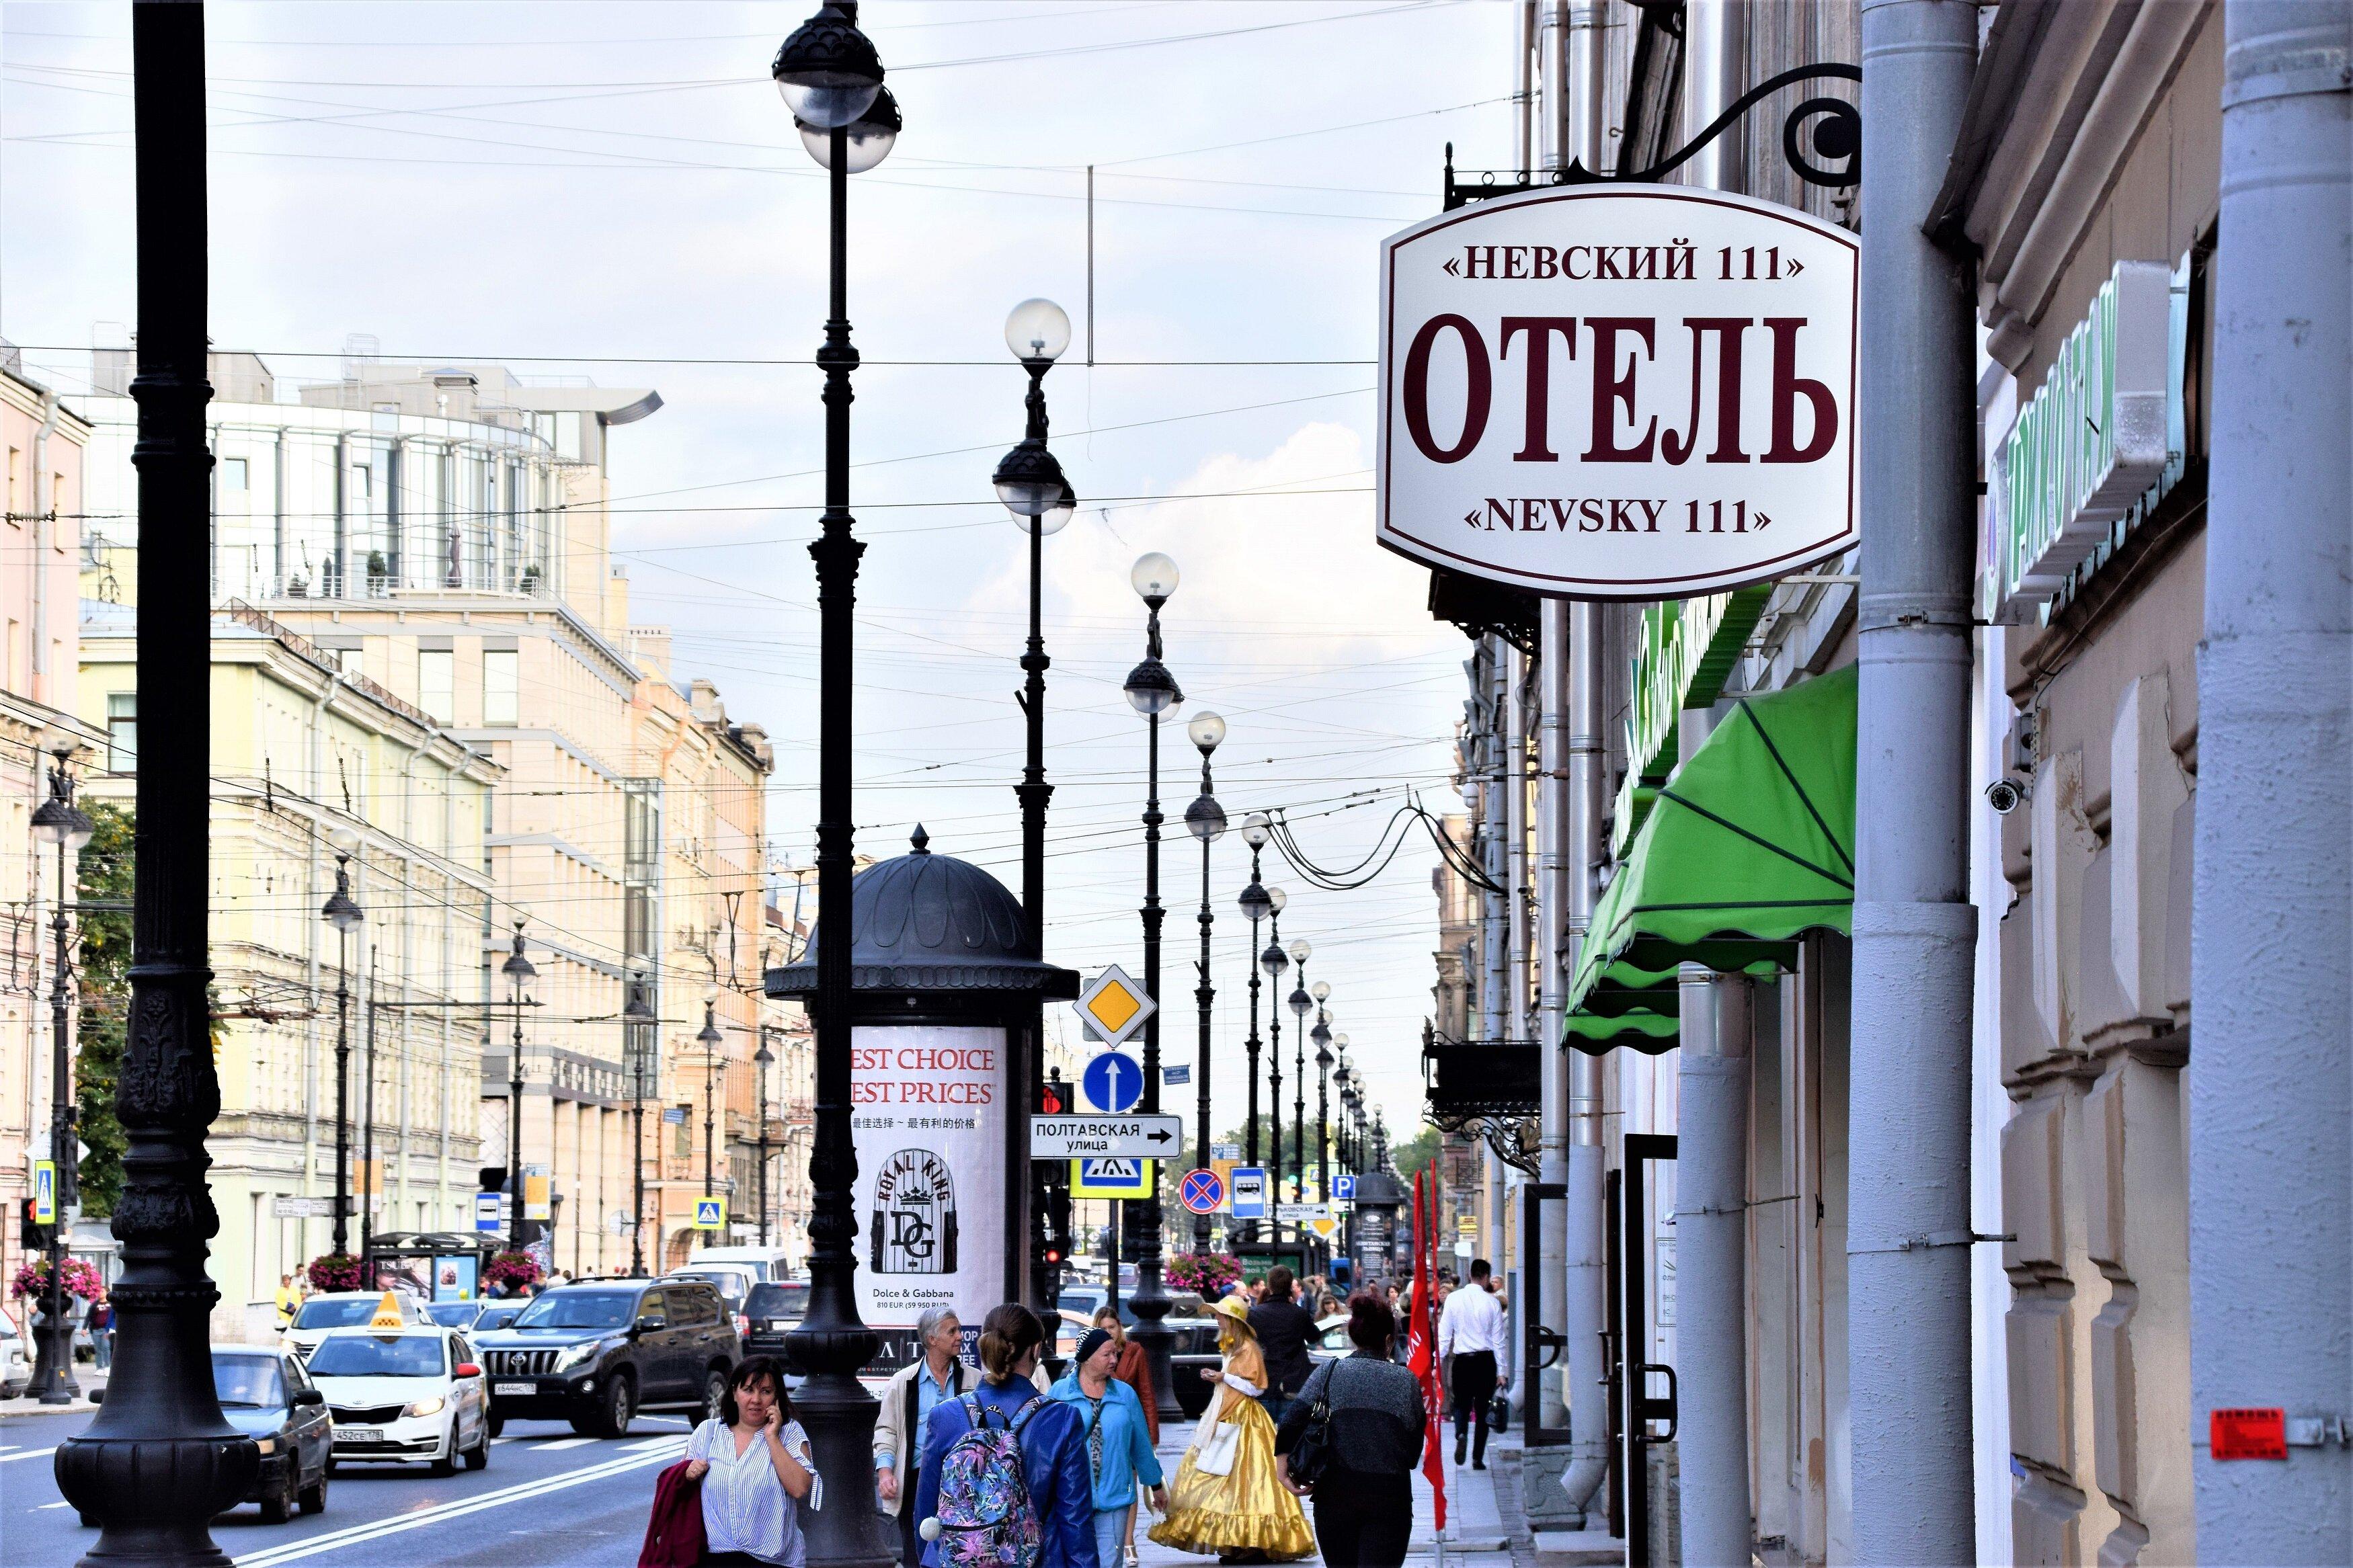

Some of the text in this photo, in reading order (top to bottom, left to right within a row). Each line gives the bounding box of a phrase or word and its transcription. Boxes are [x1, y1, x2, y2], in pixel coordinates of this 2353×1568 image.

[1443, 237, 1805, 280] «НЕВСКИЙ 111»
[1403, 313, 1839, 466] ОТЕЛЬ
[2005, 259, 2120, 603] ТРИКОТАЖ
[1464, 497, 1772, 534] «NEVSKY 111»
[851, 1048, 994, 1071] EST CHOICE
[851, 1082, 894, 1103] EST
[852, 1117, 893, 1128] 最佳选择
[908, 1117, 975, 1129] 最有利的价格
[1037, 1124, 1140, 1137] ПОЛТАВСКАЯ
[1066, 1139, 1108, 1153] улица
[877, 1155, 951, 1201] ROYAL KING
[1338, 1178, 1351, 1196] P
[873, 1288, 954, 1298] Dolce & Gabbana
[961, 1331, 978, 1342] OP
[333, 1431, 365, 1440] 452СЕ
